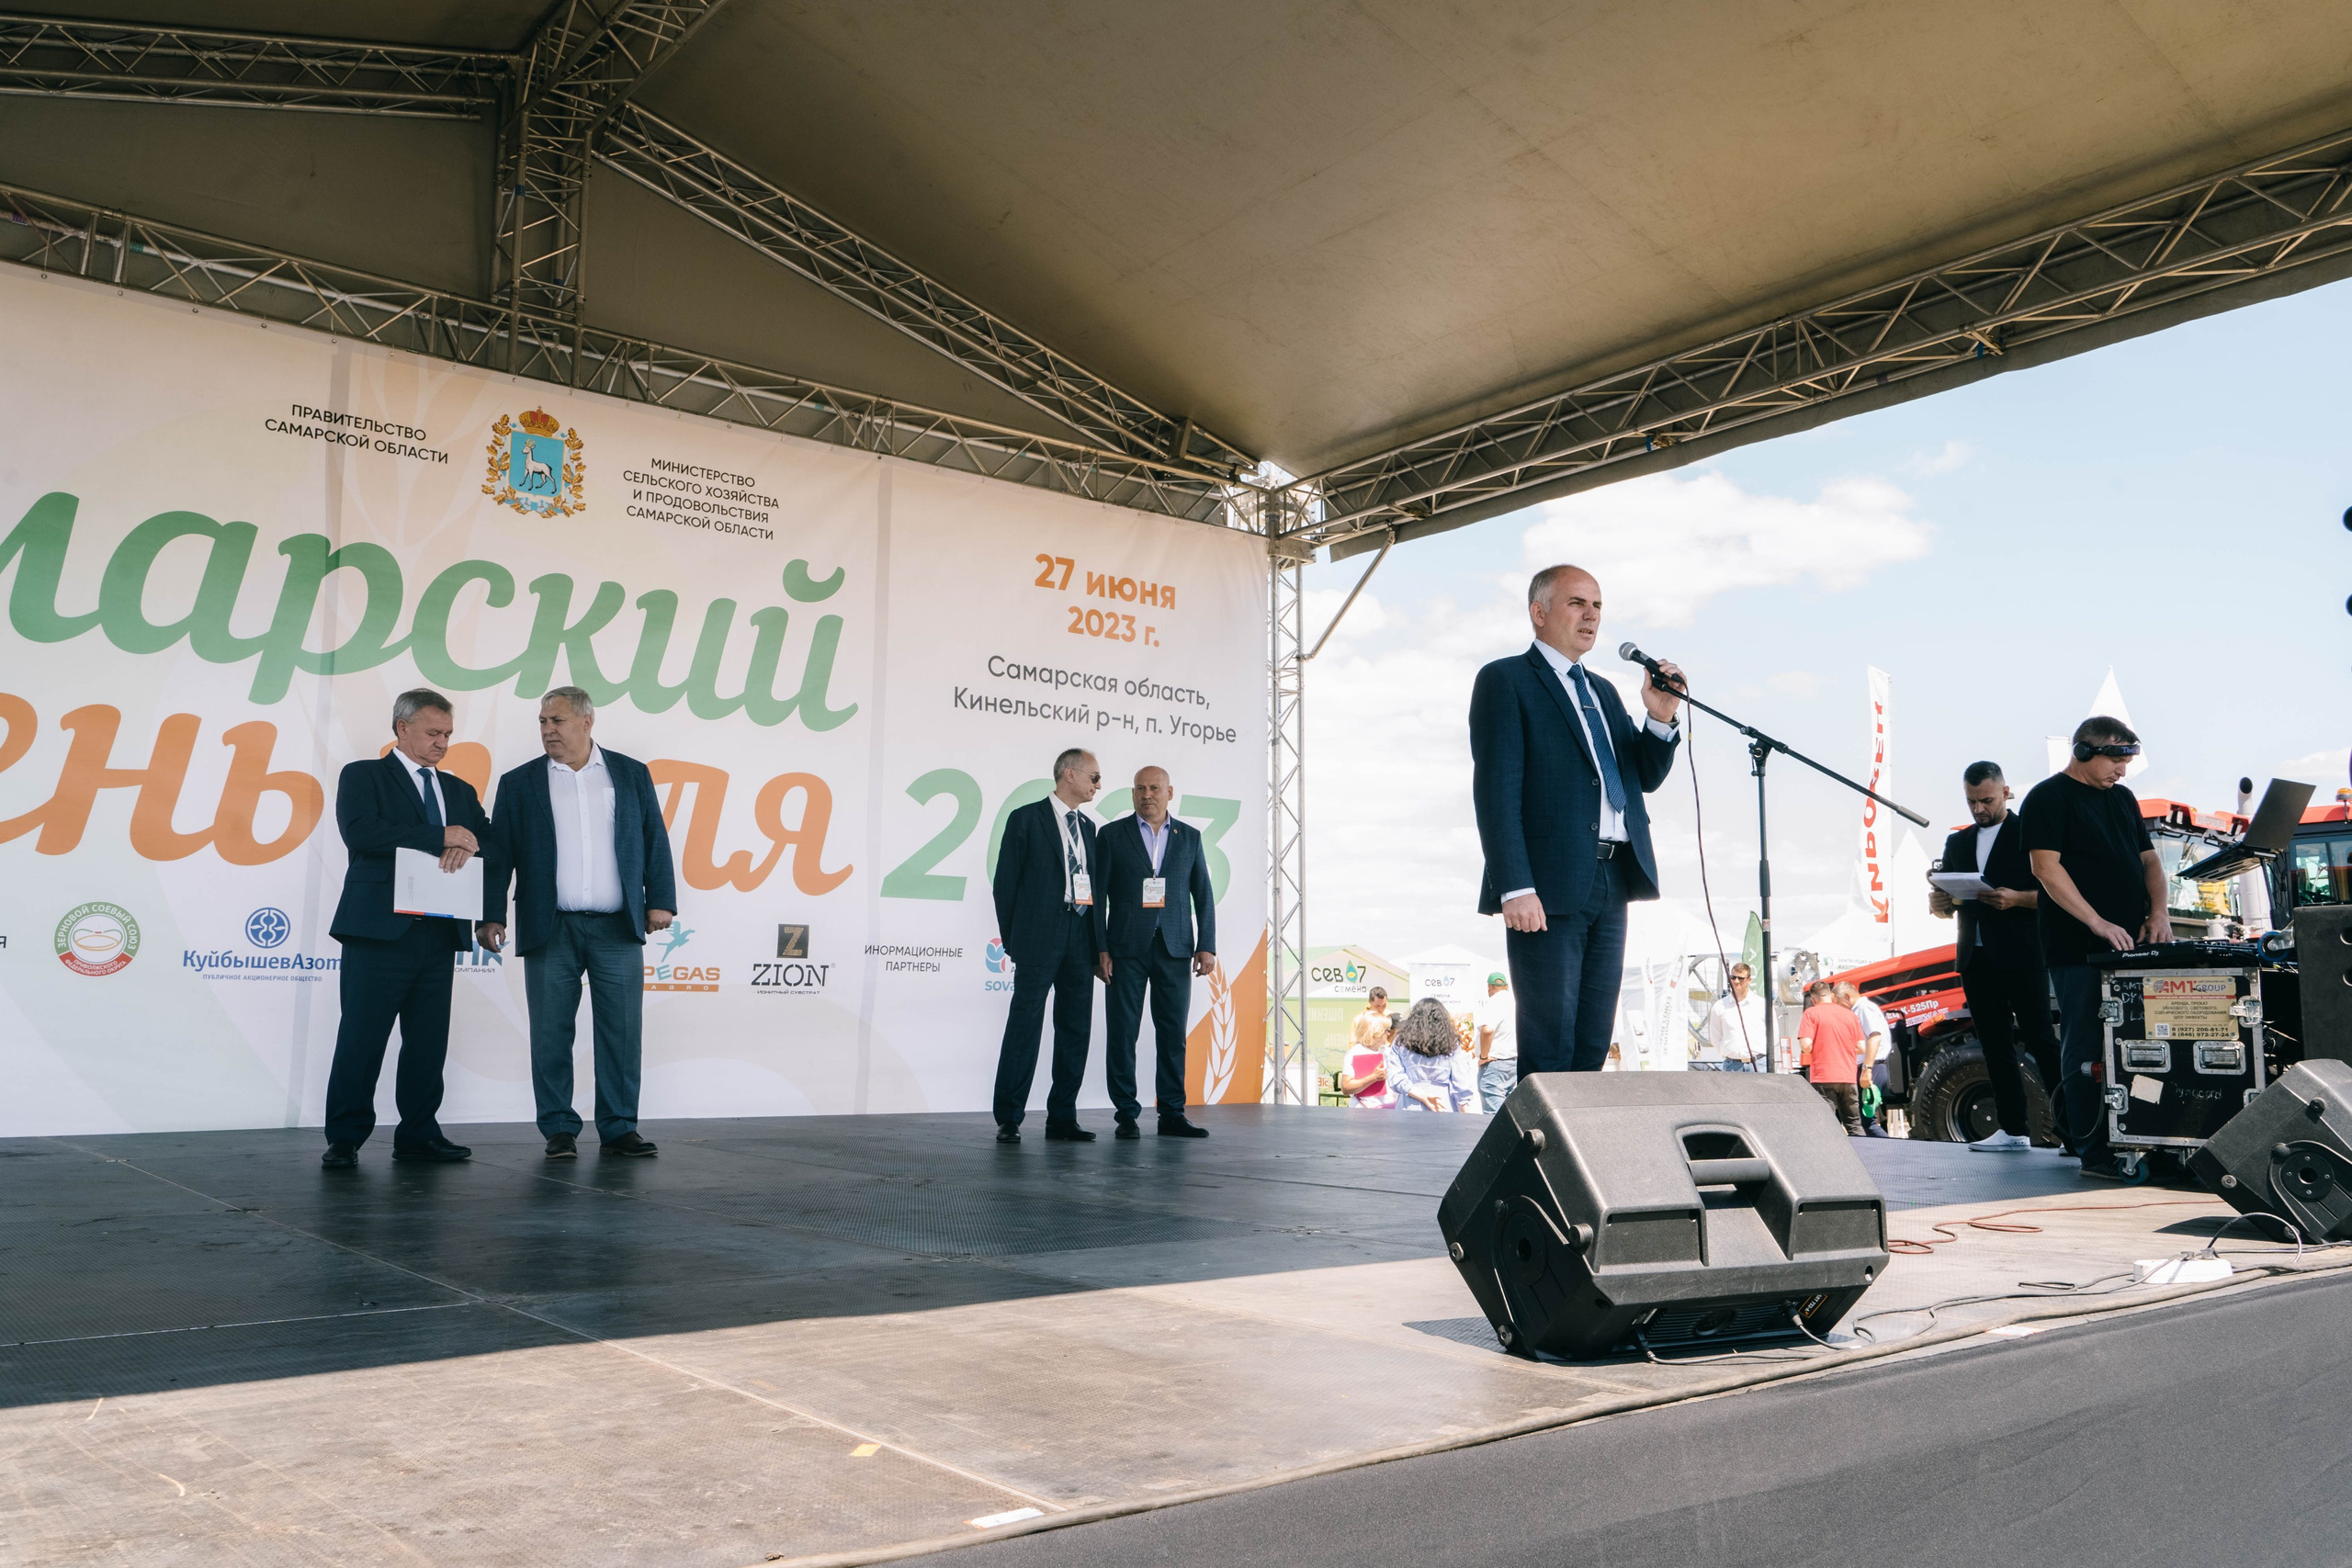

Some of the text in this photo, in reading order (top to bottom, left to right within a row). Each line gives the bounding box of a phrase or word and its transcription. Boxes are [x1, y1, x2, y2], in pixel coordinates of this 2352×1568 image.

[291, 404, 426, 441] ПРАВИТЕЛЬСТВО
[265, 418, 448, 464] САМАРСКОЙ ОБЛАСТИ
[623, 469, 779, 509] СЕЛЬСКОГО ХОЗЯЙСТВА
[650, 457, 755, 487] МИНИСТЕРСТВО
[627, 505, 774, 540] САМАРСКОЙ ОБЛАСТИ
[633, 489, 769, 523] И ПРОДОВОЛЬСТВИЯ
[1035, 553, 1176, 610] 27 июня
[0, 491, 859, 732] арский
[1068, 606, 1159, 647] 2023 г.
[988, 655, 1210, 709] Самарская область,
[954, 686, 1237, 744] Кинельский р-н, п. Угорье
[879, 768, 1242, 914] 23
[57, 904, 138, 950] ЗЕРНОВОЙ СОЕВЫЙ СОЮЗ
[64, 959, 127, 975] ФЕДЕРАЛЬНОГО ОКРУГА
[73, 959, 119, 970] ПРИВОЛЖСКОГО
[865, 945, 963, 958] ИНОРМАЦИОННЫЕ
[885, 961, 941, 972] ПАРТНЕРЫ
[751, 964, 830, 987] ZION
[2159, 980, 2198, 993] AMT
[2196, 984, 2226, 992] GROUP
[1901, 999, 1939, 1014] К-525Пр
